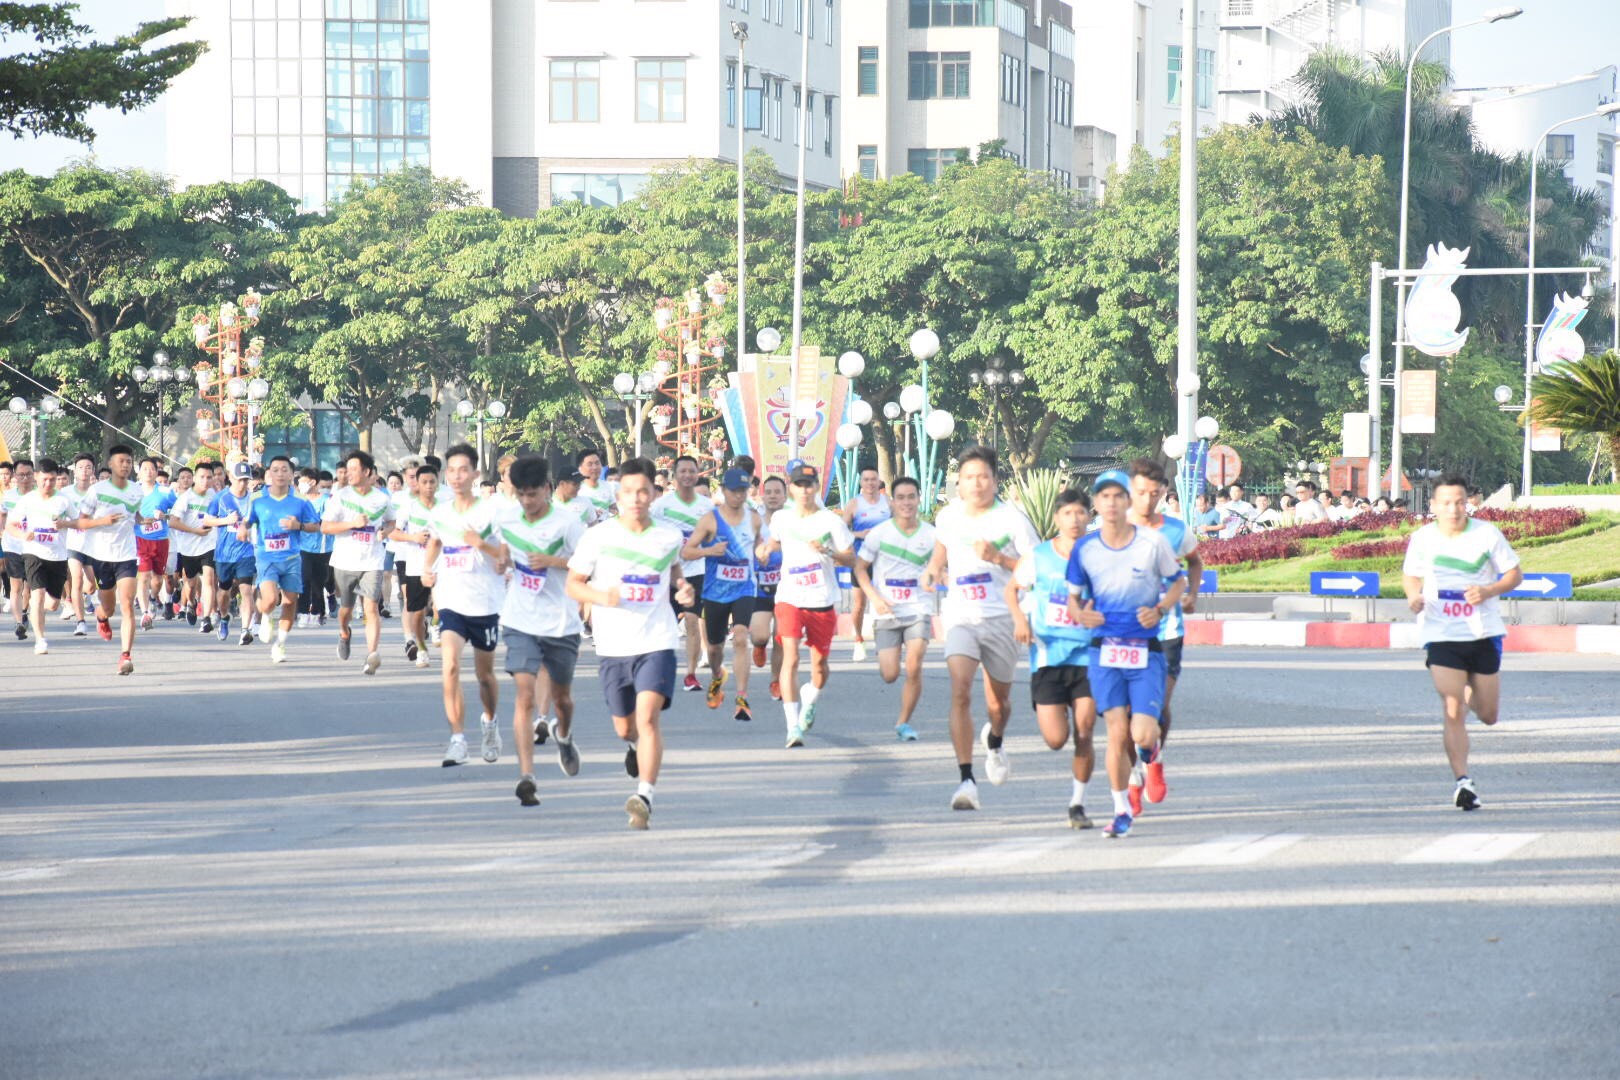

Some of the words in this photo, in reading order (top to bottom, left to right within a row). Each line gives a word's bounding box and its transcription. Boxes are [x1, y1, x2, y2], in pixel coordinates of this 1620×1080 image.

[37, 534, 53, 542] 174
[269, 540, 286, 549] 439
[722, 567, 744, 579] 422
[796, 573, 817, 586] 438
[627, 587, 654, 602] 332
[892, 588, 911, 600] 139
[963, 585, 986, 600] 133
[1443, 602, 1473, 617] 400
[1109, 648, 1139, 664] 398
